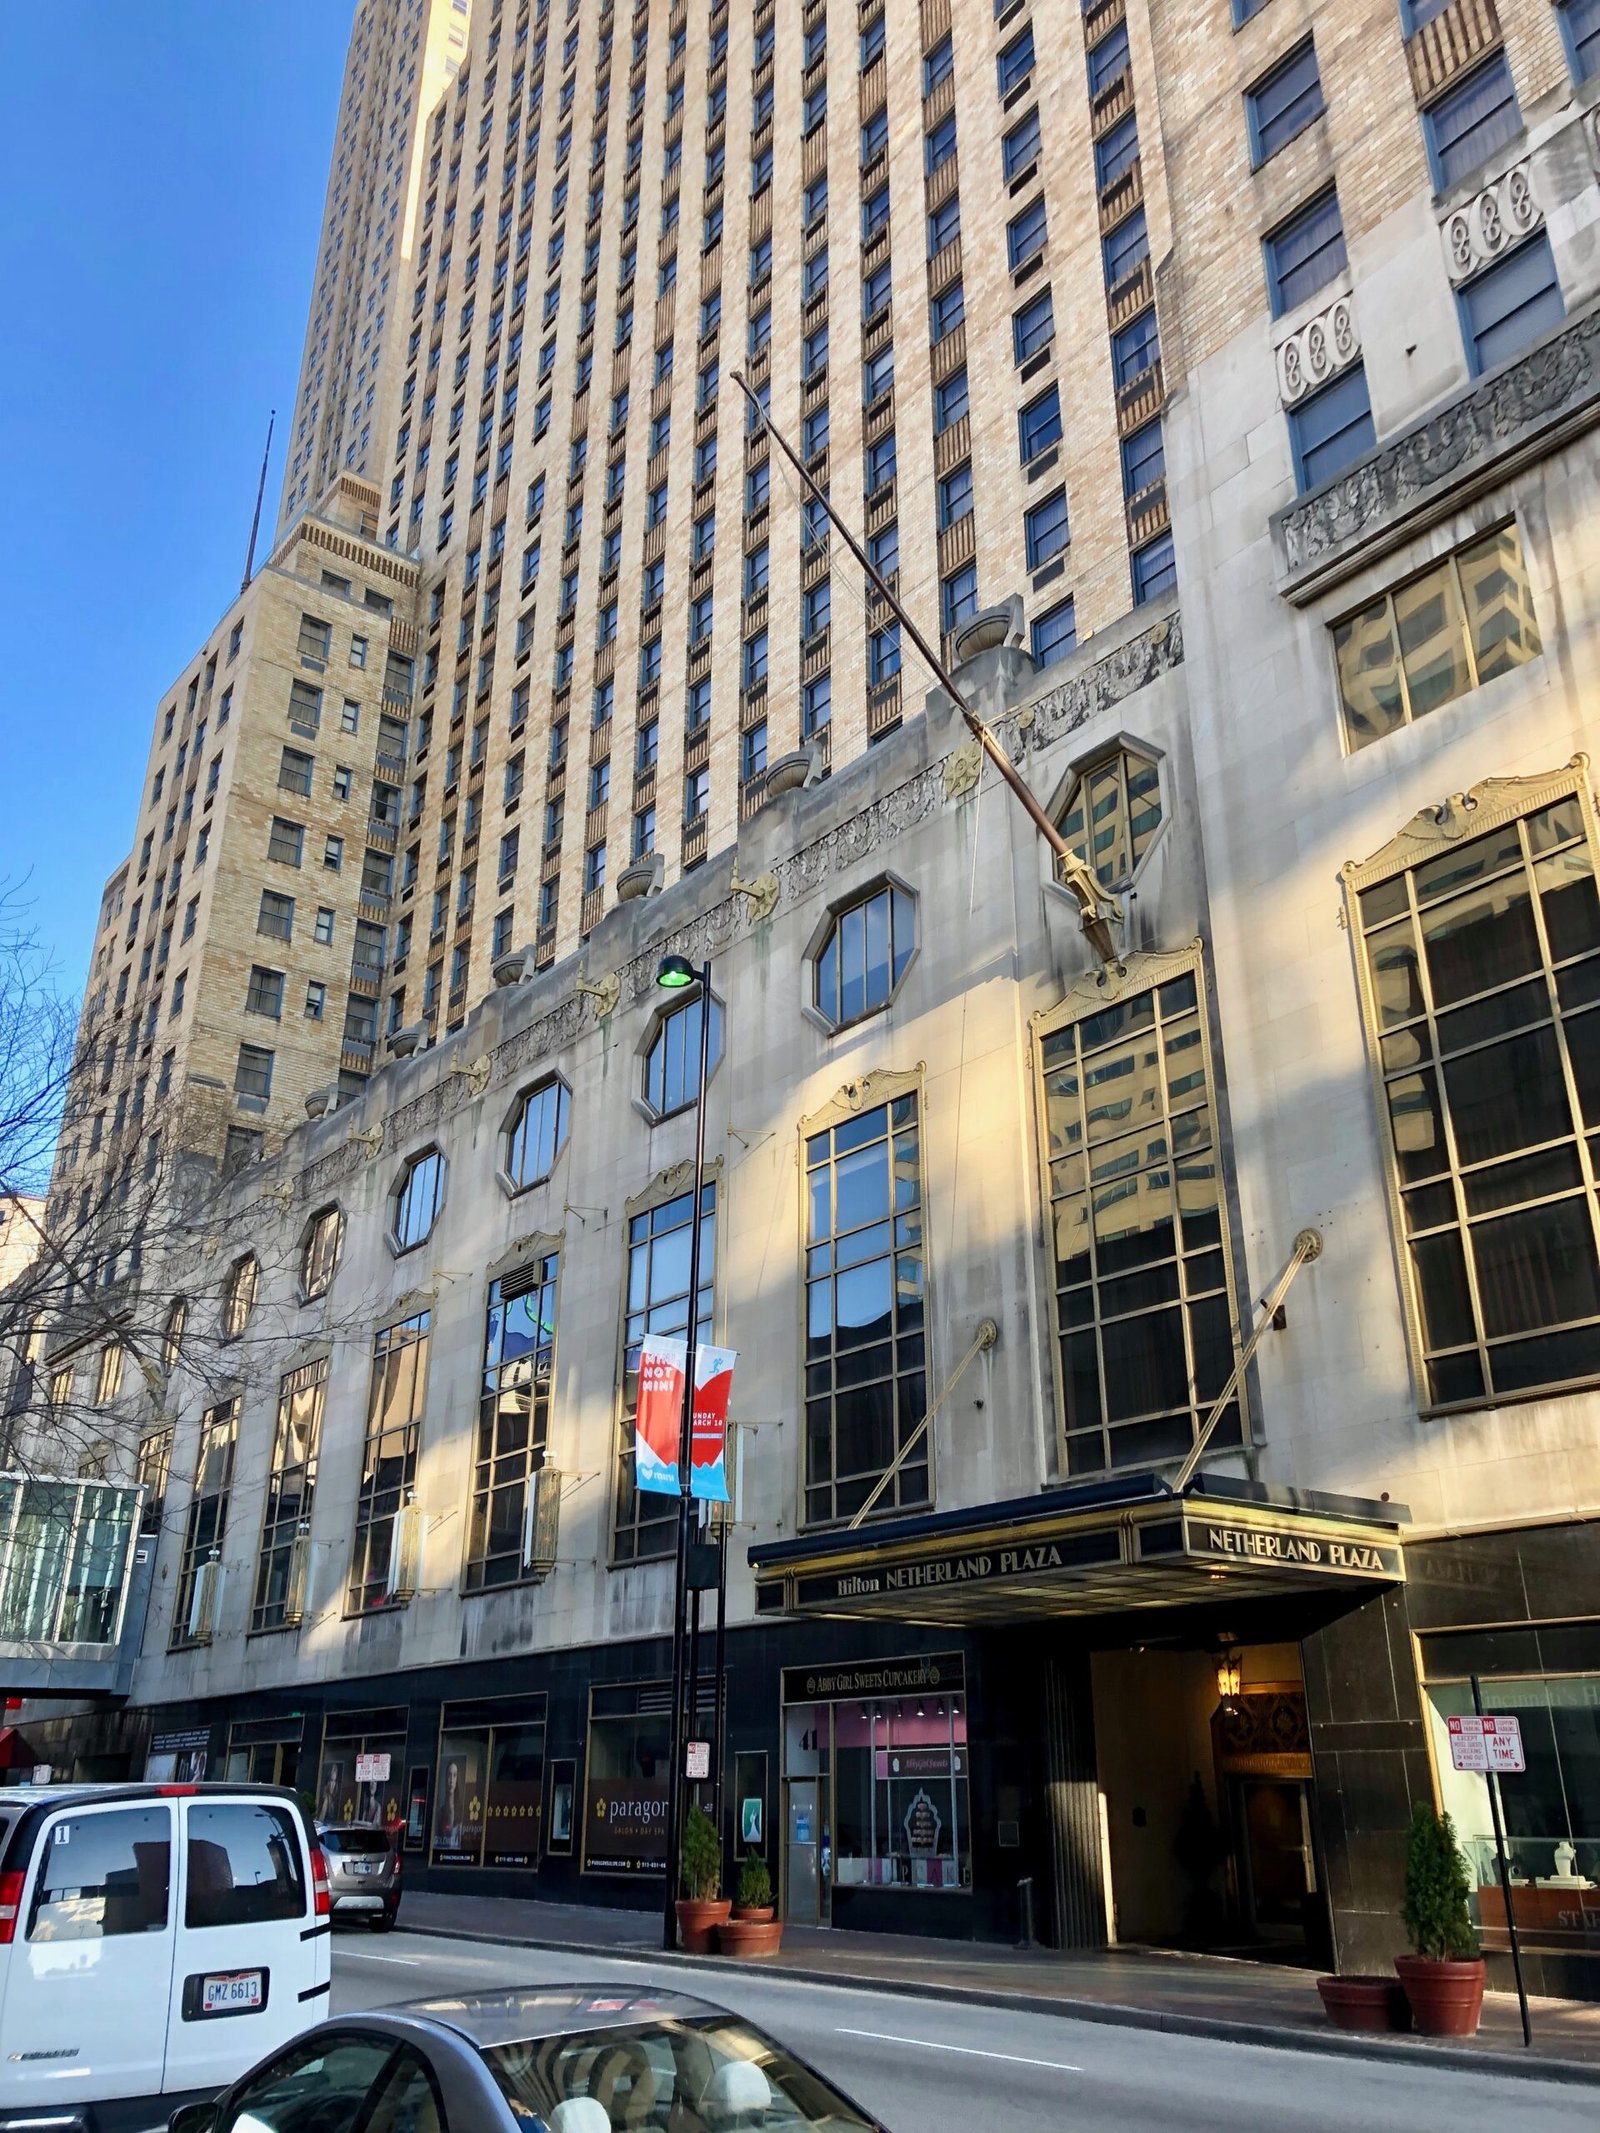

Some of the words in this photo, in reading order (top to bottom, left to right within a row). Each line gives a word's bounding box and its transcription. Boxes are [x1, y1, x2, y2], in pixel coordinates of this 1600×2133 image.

[643, 1366, 672, 1378] NOT
[642, 1380, 674, 1392] MINI
[692, 1412, 716, 1420] UNDAY
[692, 1419, 712, 1427] ARCH
[1209, 1527, 1321, 1562] NETHERLAND
[1330, 1544, 1385, 1571] PLAZA
[837, 1576, 880, 1596] Hilton
[886, 1555, 992, 1591] NETHERLAND
[1000, 1545, 1063, 1573] PLAZA
[817, 1676, 837, 1692] ABBY
[837, 1673, 854, 1691] GIRL
[854, 1672, 882, 1690] SWEETS
[882, 1668, 928, 1687] CUPCAKERY
[1583, 1685, 1600, 1705] H
[1449, 1720, 1460, 1731] NO
[1483, 1720, 1495, 1731] NO
[799, 1729, 817, 1751] 41
[1492, 1737, 1512, 1747] ANY
[1493, 1749, 1515, 1760] TIME
[58, 1827, 66, 1843] 1
[208, 1983, 228, 2001] GMZ
[231, 1981, 257, 1999] 6613
